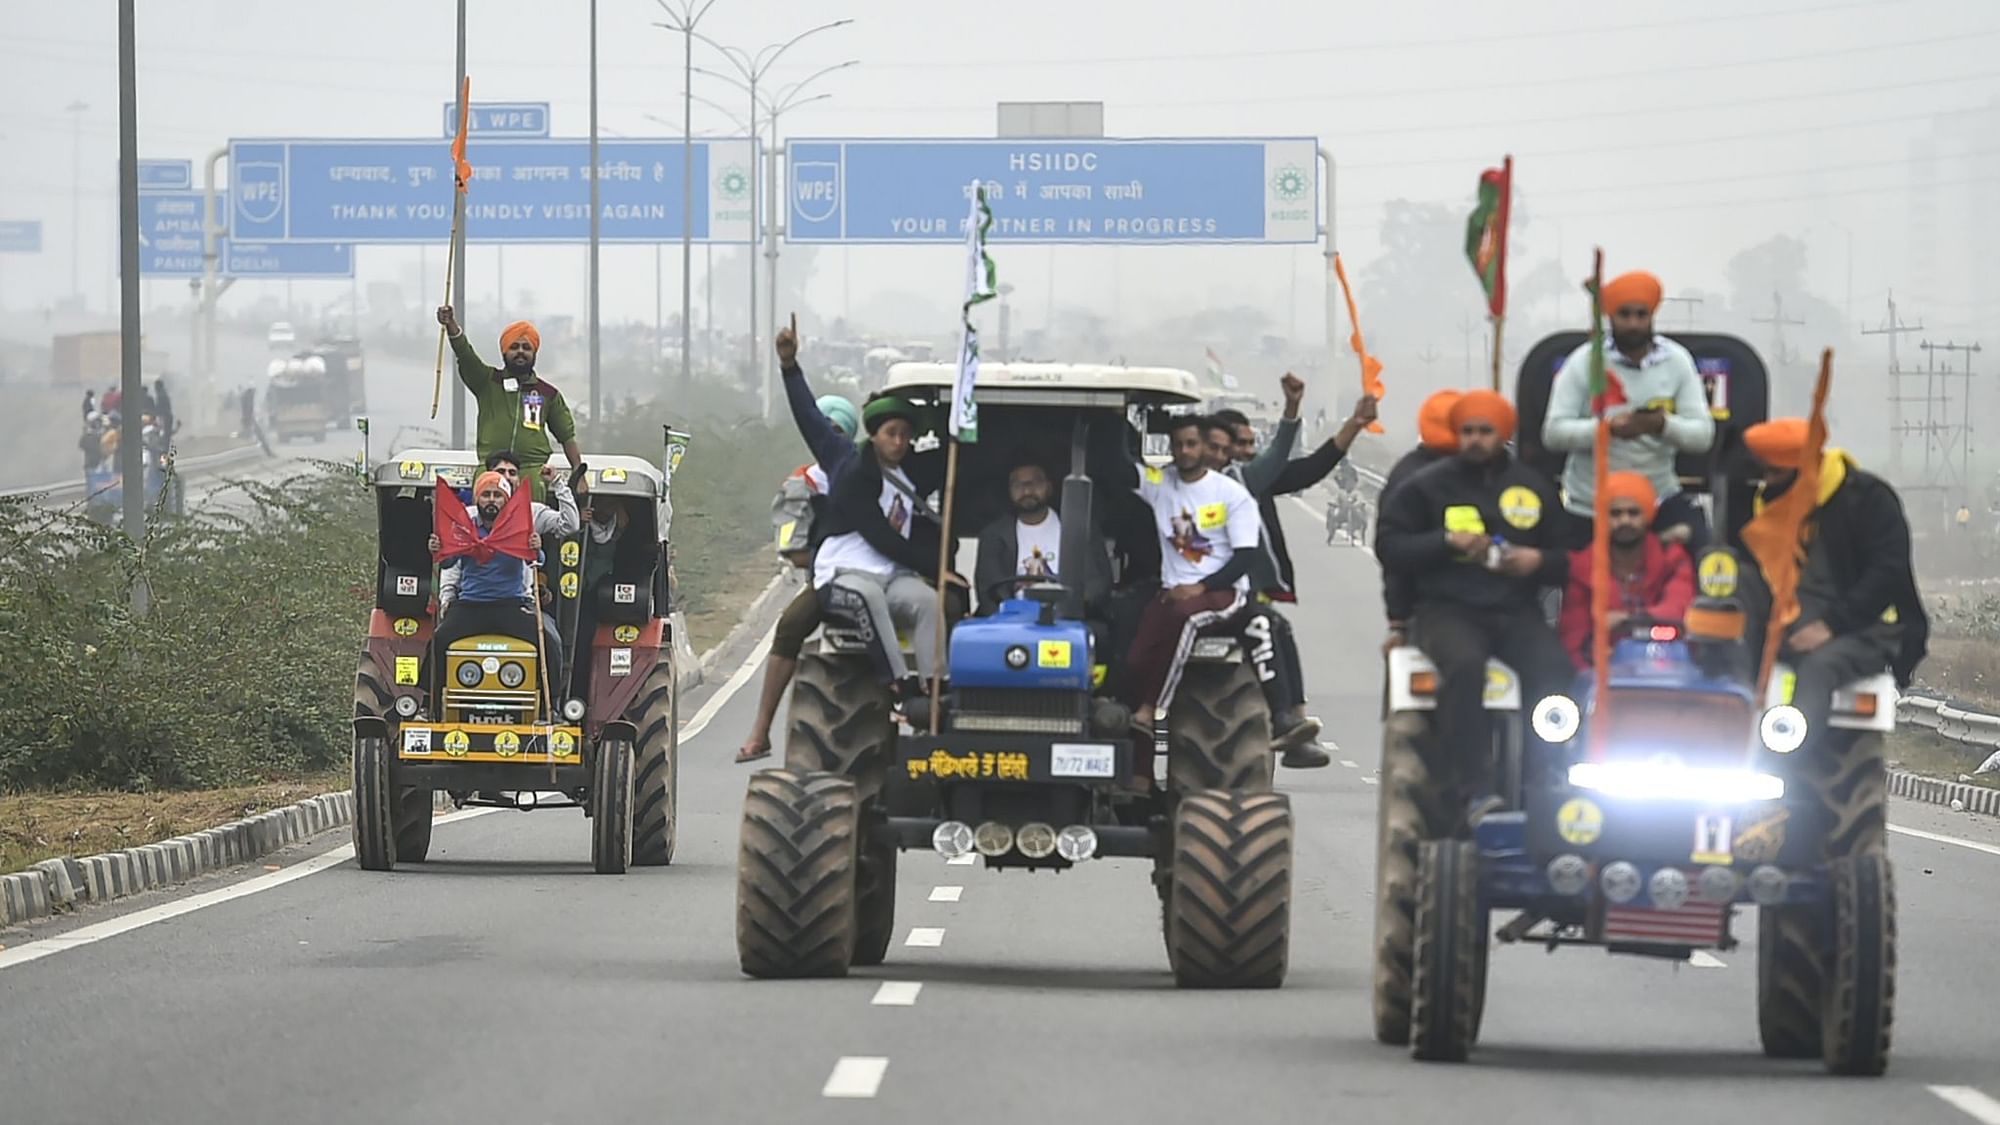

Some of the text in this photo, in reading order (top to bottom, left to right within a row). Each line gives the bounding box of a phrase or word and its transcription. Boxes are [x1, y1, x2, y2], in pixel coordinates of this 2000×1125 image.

[490, 113, 535, 128] WPE
[1009, 153, 1098, 171] HSIIDC
[242, 182, 278, 202] WPE
[798, 181, 835, 201] WPE
[1014, 179, 1028, 200] में
[1040, 184, 1092, 200] आपका
[1103, 179, 1144, 200] साथी
[331, 204, 399, 219] THANK
[602, 203, 665, 219] AGAIN
[890, 218, 948, 233] YOUR
[1068, 218, 1092, 233] IN
[1104, 218, 1217, 233] PROGRESS
